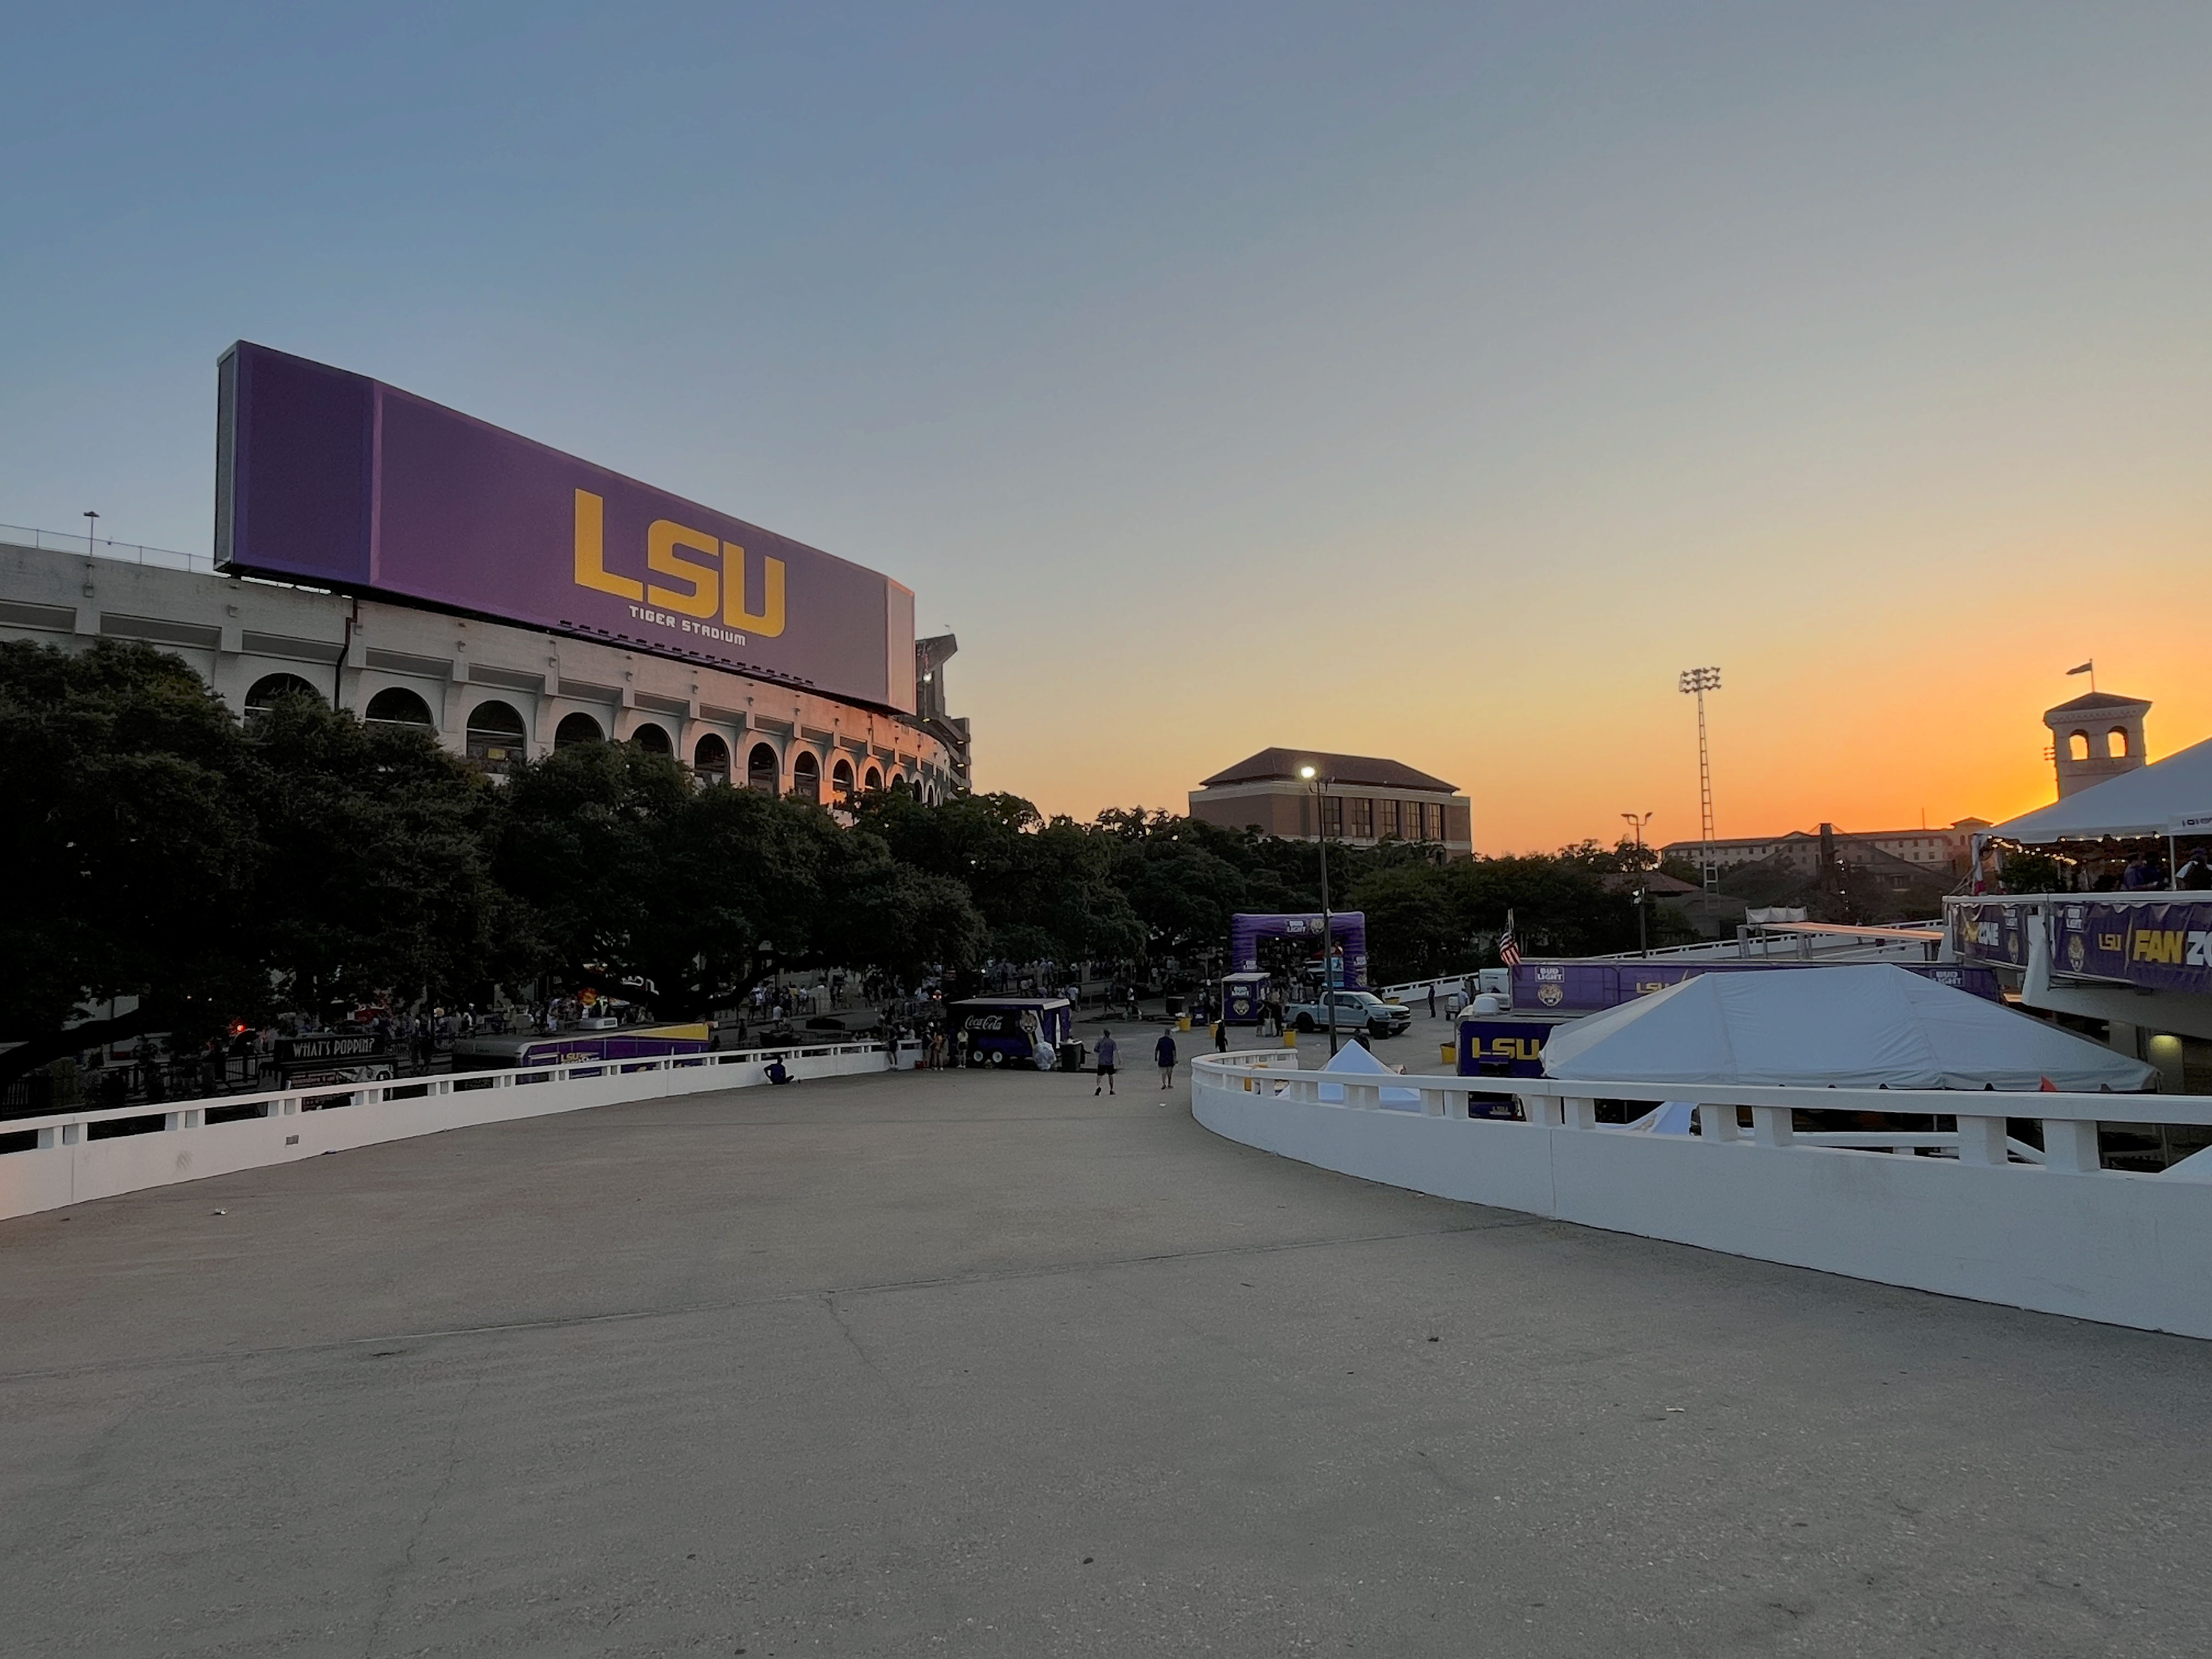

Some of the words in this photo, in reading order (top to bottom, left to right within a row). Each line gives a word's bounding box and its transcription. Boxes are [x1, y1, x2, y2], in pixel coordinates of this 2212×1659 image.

[574, 488, 786, 638] LSU
[629, 605, 675, 628] TIGER
[681, 619, 745, 646] STADIUM
[2098, 933, 2122, 951] LSU
[2133, 929, 2184, 964] FAN
[292, 1041, 330, 1058] WHAT'S
[1472, 1037, 1539, 1060] LSU
